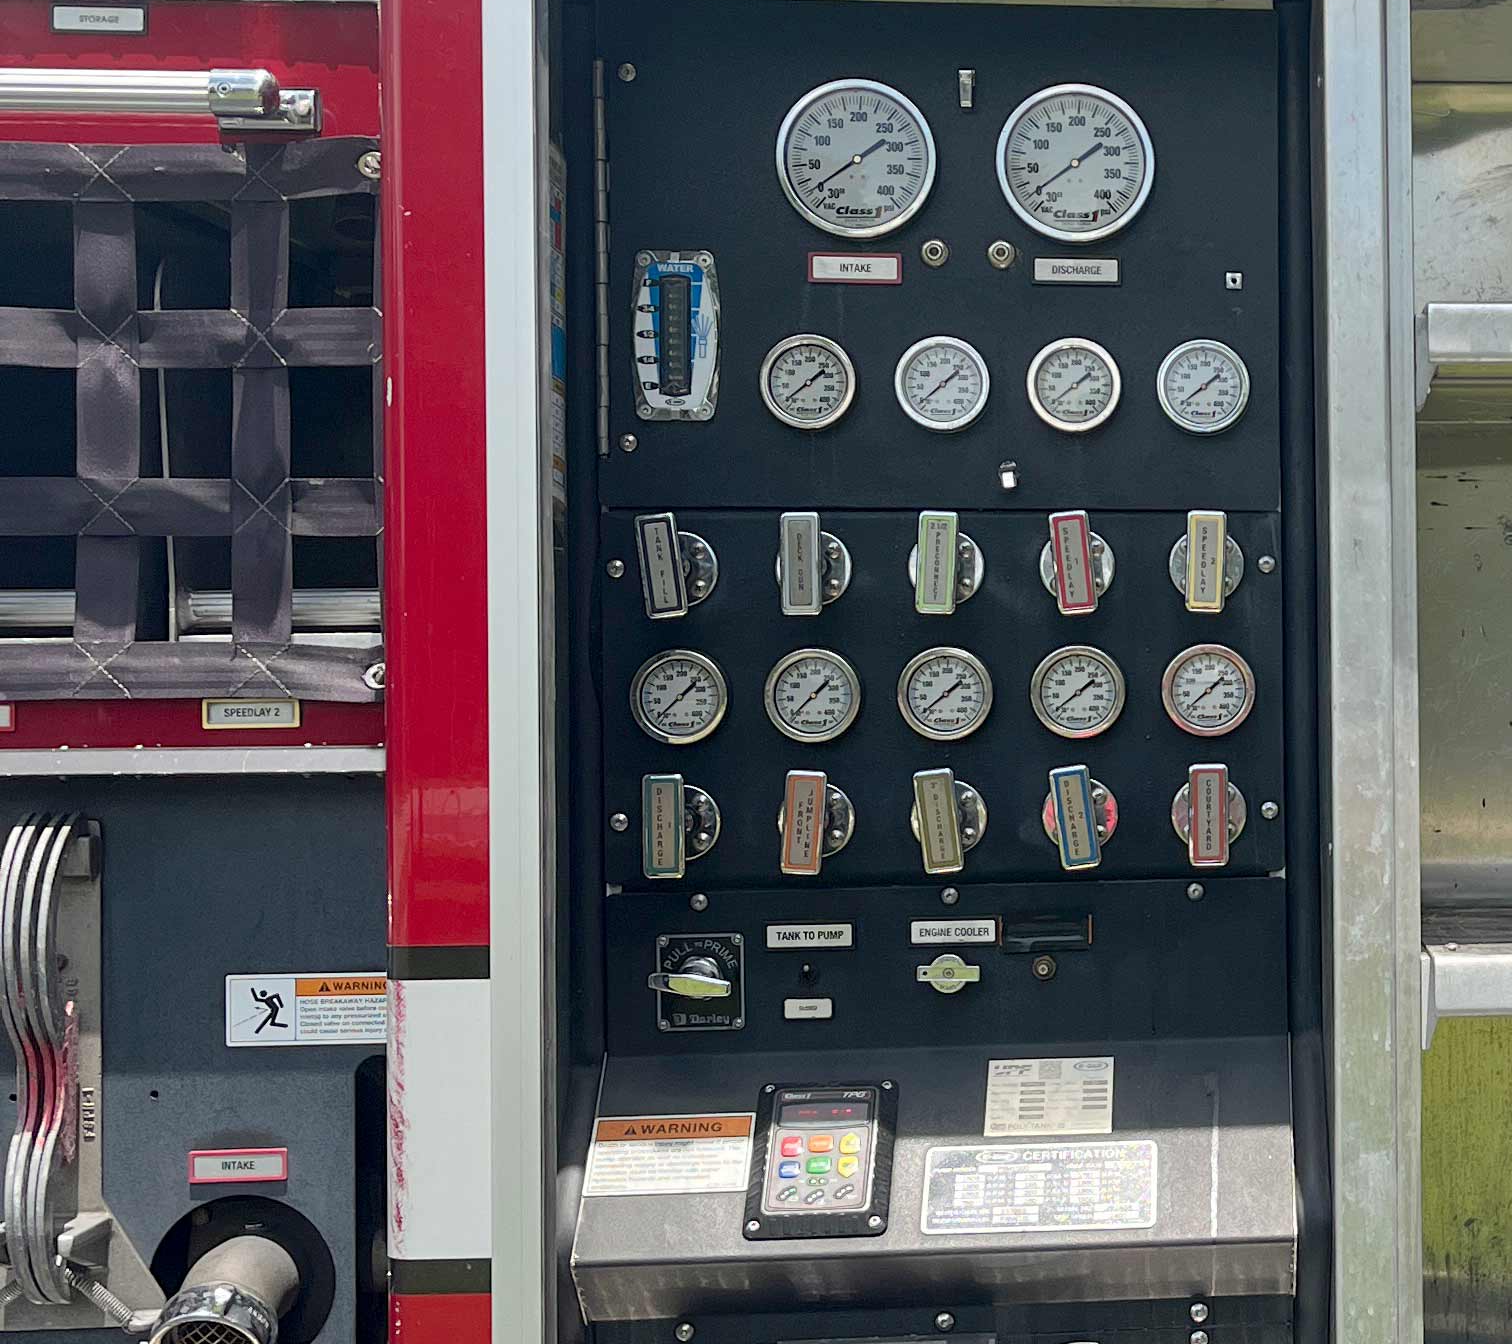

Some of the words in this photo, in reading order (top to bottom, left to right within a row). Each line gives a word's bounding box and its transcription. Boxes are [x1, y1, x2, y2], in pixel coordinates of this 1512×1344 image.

[79, 15, 120, 23] STORAGE
[850, 112, 868, 122] 200
[1068, 116, 1086, 126] 200
[827, 119, 844, 129] 150
[876, 123, 894, 134] 250
[1046, 123, 1063, 133] 150
[1093, 127, 1111, 138] 250
[814, 136, 831, 146] 100
[1033, 140, 1049, 150] 100
[886, 142, 904, 152] 300
[1103, 146, 1121, 157] 300
[808, 159, 821, 170] 50
[886, 164, 905, 175] 350
[1027, 163, 1039, 174] 50
[1104, 169, 1121, 179] 350
[876, 185, 895, 196] 400
[1094, 189, 1112, 200] 400
[656, 263, 694, 273] WATER
[839, 263, 872, 273] INTAKE
[1051, 264, 1103, 276] DISCHARGE
[930, 522, 935, 530] 2
[1063, 527, 1074, 598] SPEEDLAY
[1200, 526, 1208, 593] SPEEDLAY
[654, 528, 663, 561] TANK
[660, 570, 669, 604] FILL
[934, 532, 942, 601] PRECONNECT
[223, 707, 271, 717] SPEEDLAY
[274, 707, 280, 717] 2
[796, 802, 804, 844] FRONT
[804, 789, 814, 858] JUMPLINE
[1064, 781, 1080, 856] DISCHARGE
[656, 787, 665, 866] DISCHARGE
[933, 794, 945, 859] DISCHARGE
[776, 931, 800, 941] TANK
[802, 931, 816, 940] TO
[817, 931, 844, 940] PUMP
[919, 927, 952, 937] ENGINE
[954, 927, 990, 937] COOLER
[664, 942, 693, 970] PULL
[703, 939, 739, 970] PRIME
[688, 1014, 730, 1025] Darley
[640, 1122, 723, 1135] WARNING
[1022, 1149, 1126, 1162] CERTIFICATION
[221, 1160, 256, 1170] INTAKE
